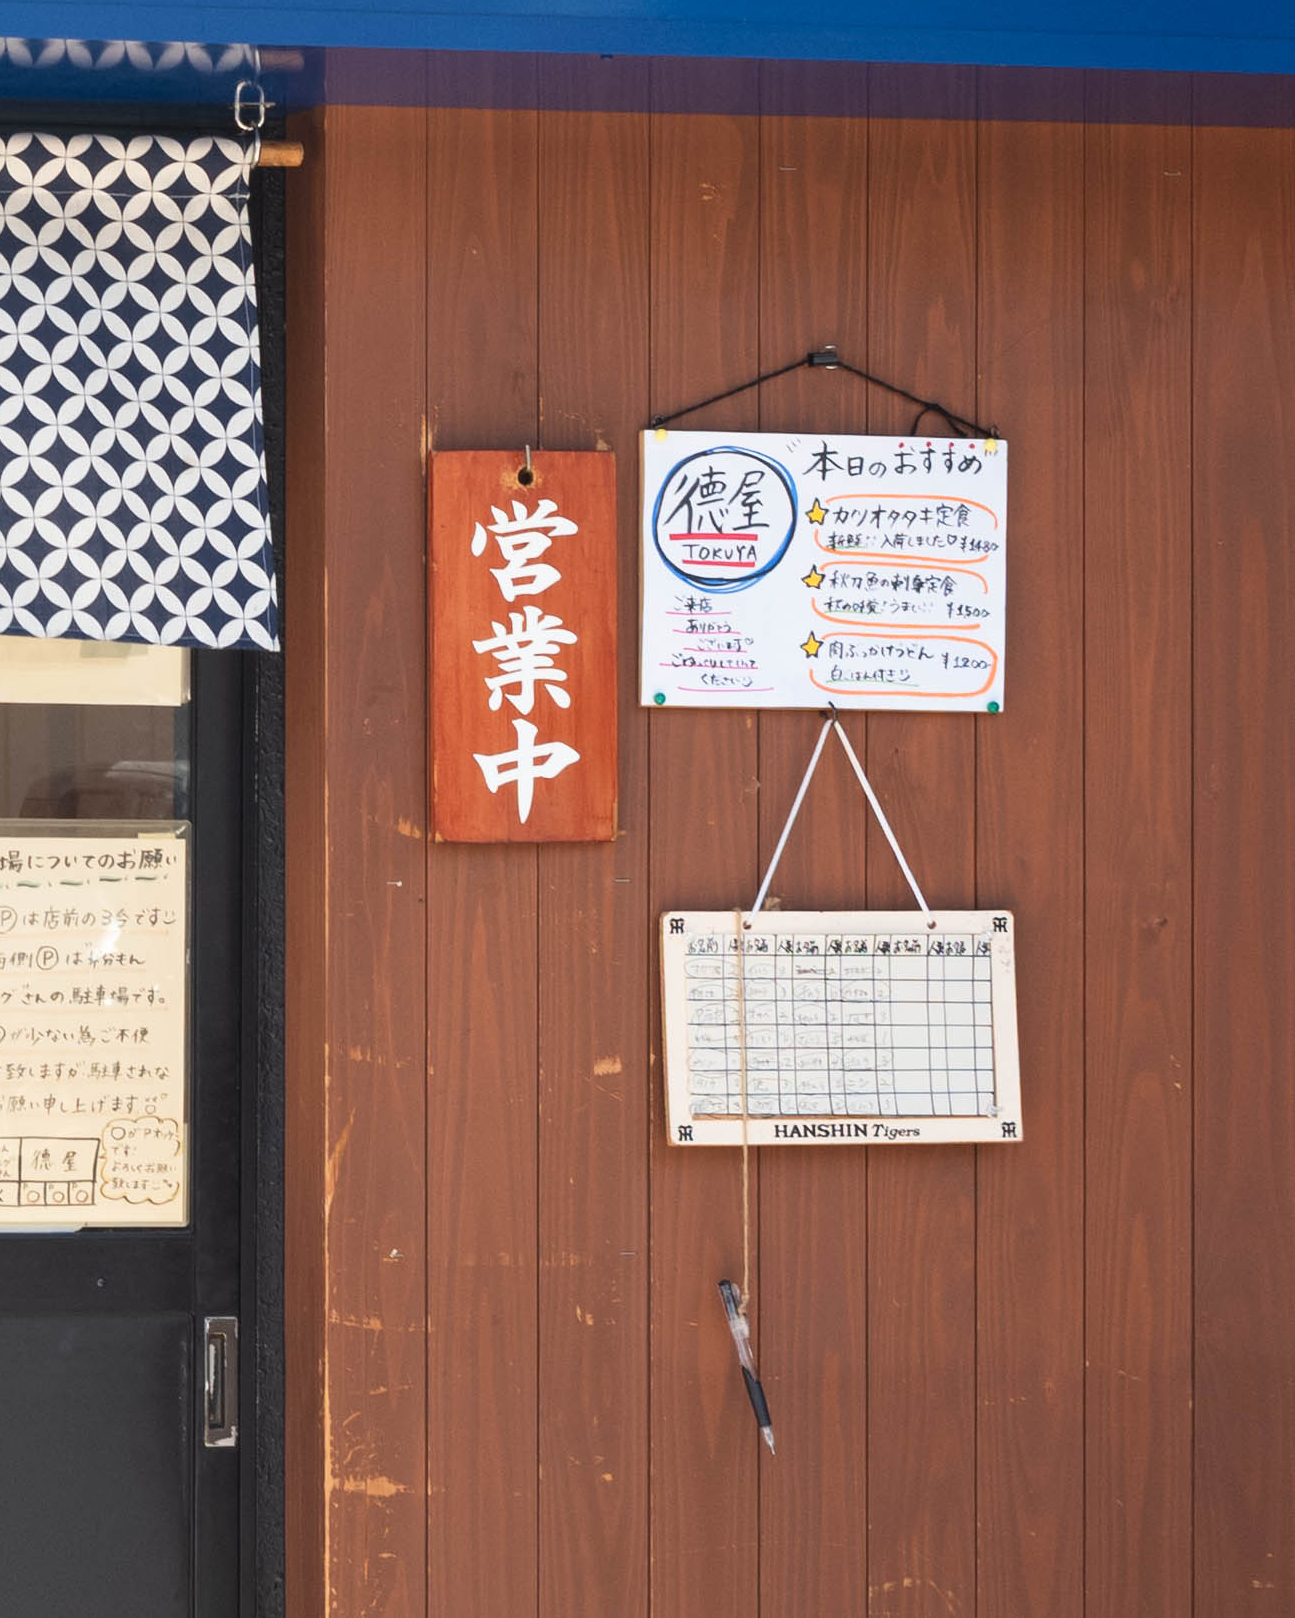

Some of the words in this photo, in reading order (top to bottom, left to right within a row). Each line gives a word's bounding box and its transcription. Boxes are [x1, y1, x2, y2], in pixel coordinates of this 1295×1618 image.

[802, 440, 984, 482] 本日のおすすめ
[833, 504, 971, 529] カツオタタキ定食
[683, 543, 758, 562] TOKUYA
[470, 499, 581, 824] 営業中
[774, 1123, 869, 1139] HANSHIN
[871, 1123, 921, 1139] Tigers
